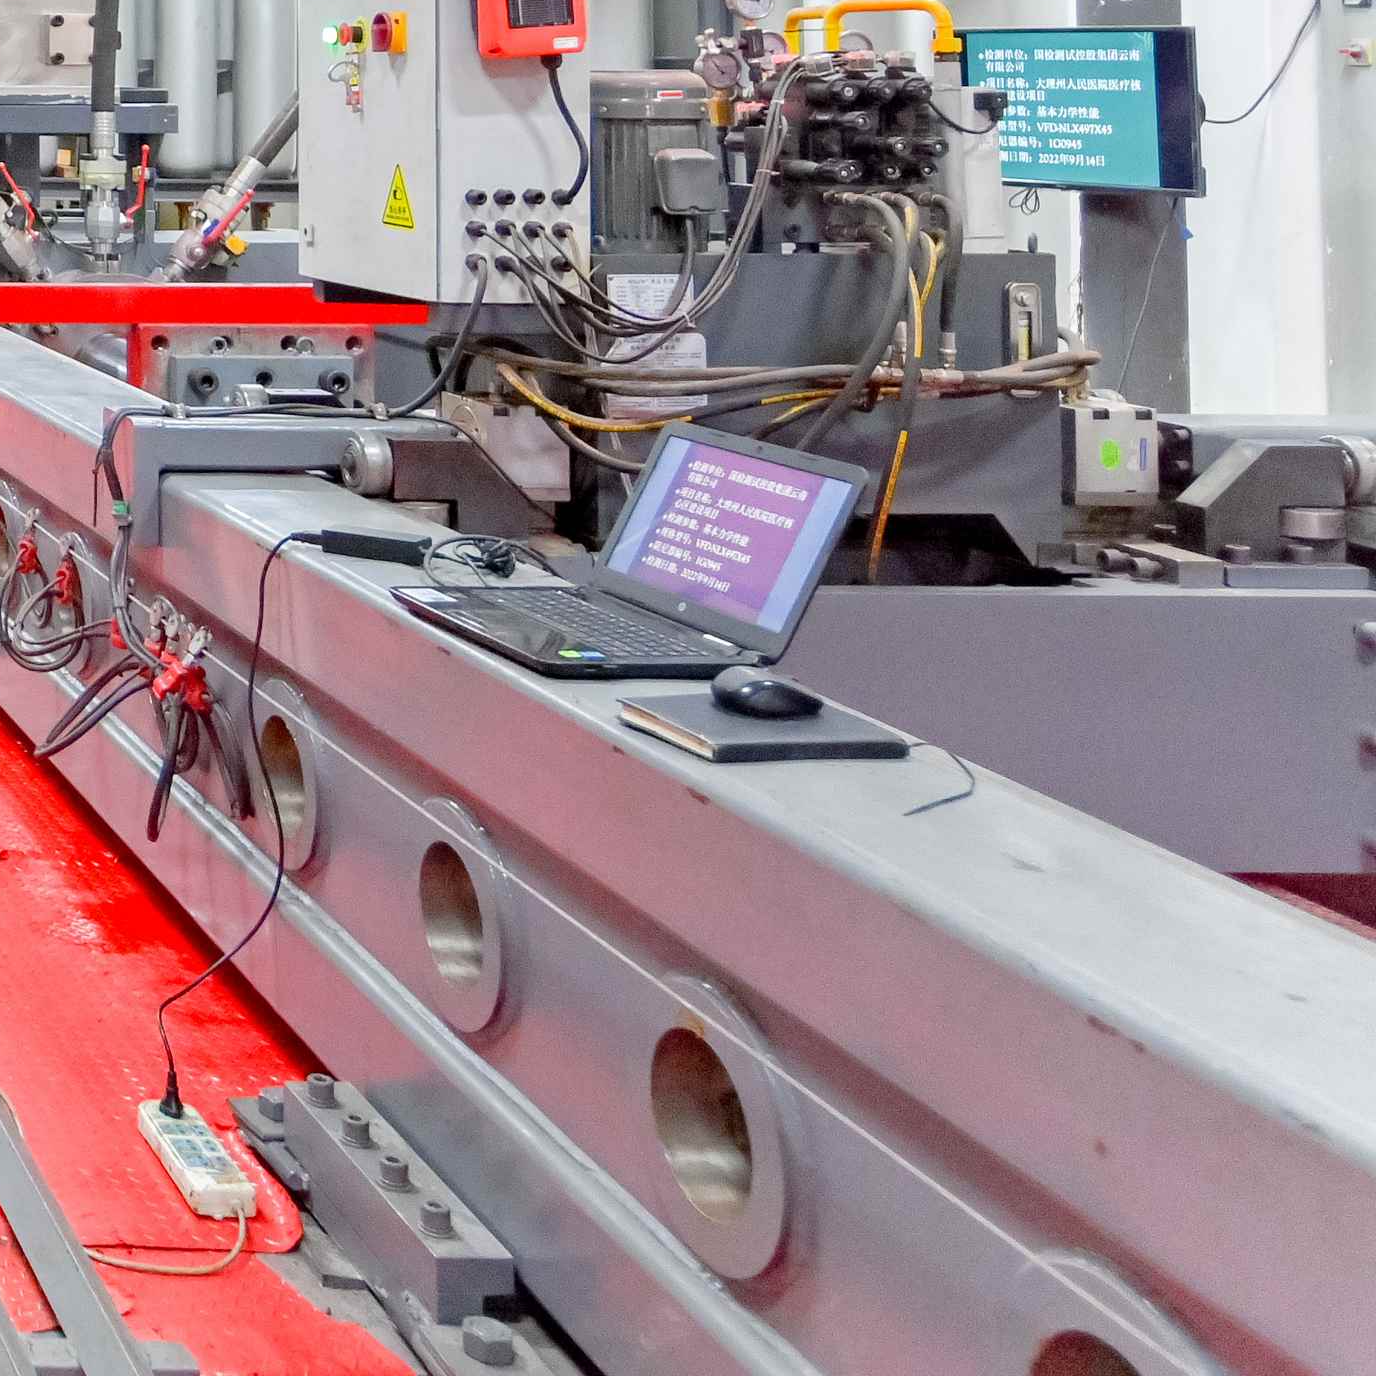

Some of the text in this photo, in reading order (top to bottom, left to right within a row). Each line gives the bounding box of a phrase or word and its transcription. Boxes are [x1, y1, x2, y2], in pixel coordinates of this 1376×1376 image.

[985, 61, 1025, 73] 有限公司
[1006, 90, 1046, 102] 建设项目
